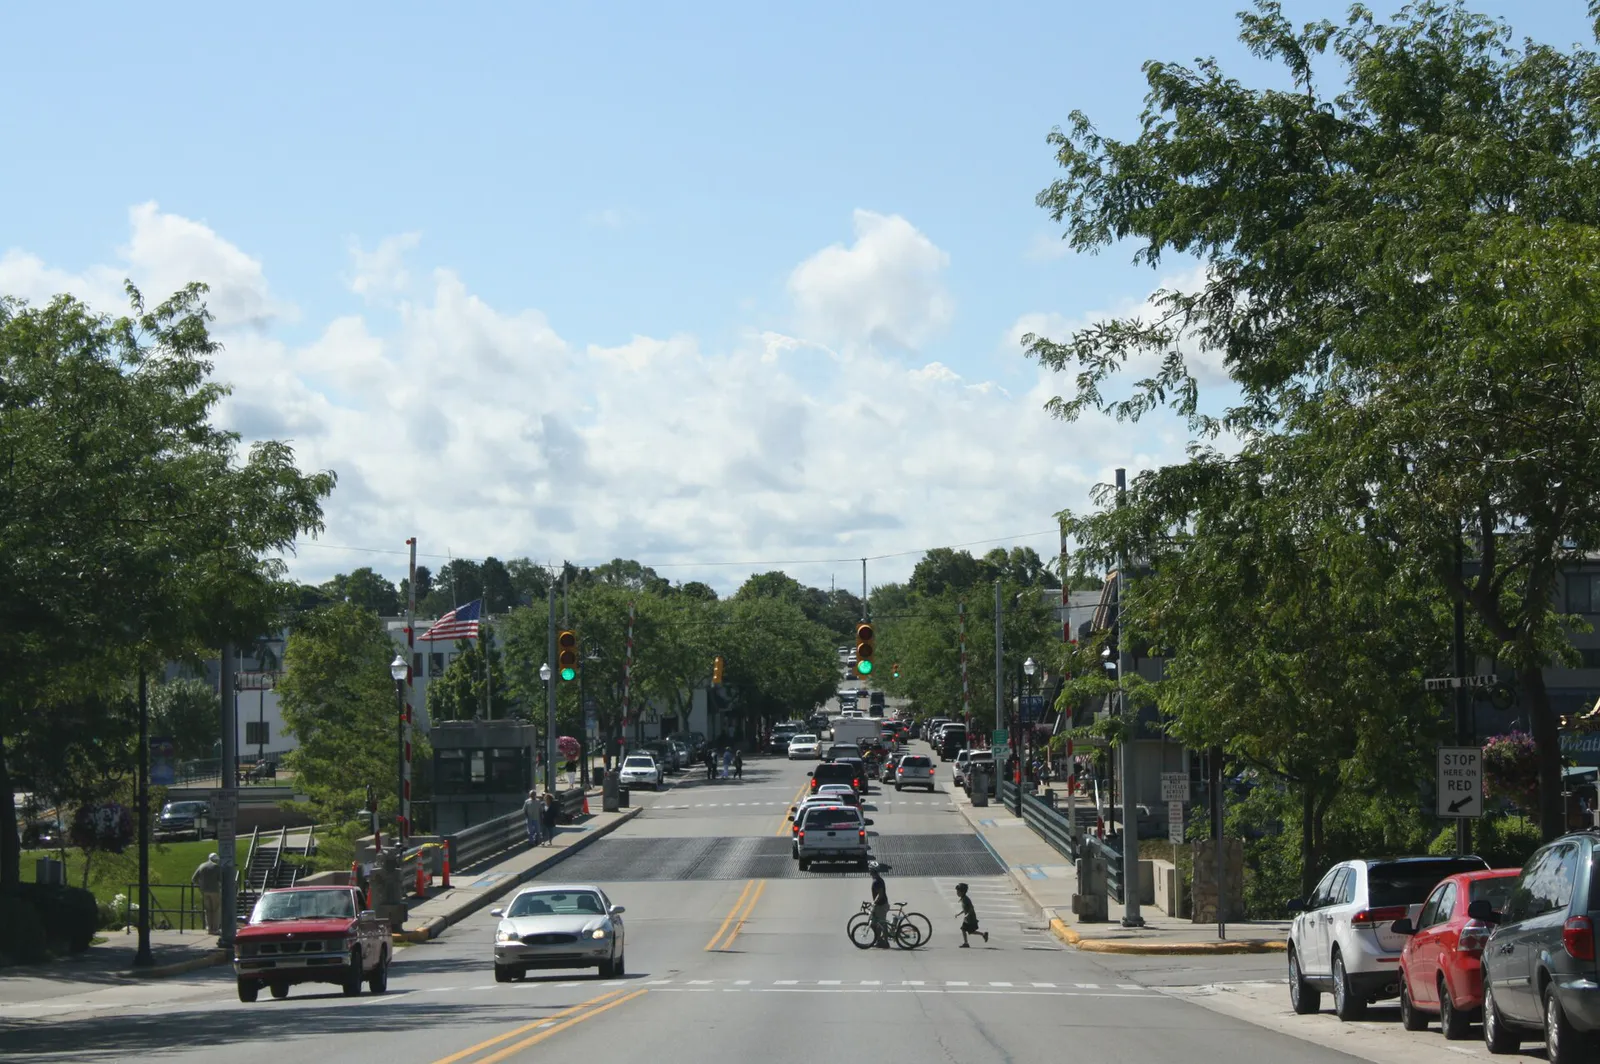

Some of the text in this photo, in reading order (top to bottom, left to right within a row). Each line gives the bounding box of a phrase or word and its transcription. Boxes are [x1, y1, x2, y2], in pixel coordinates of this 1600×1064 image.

[1460, 675, 1494, 687] RIVER
[1444, 754, 1476, 766] STOP
[1444, 769, 1477, 777] HERE ON
[1448, 780, 1472, 791] RED
